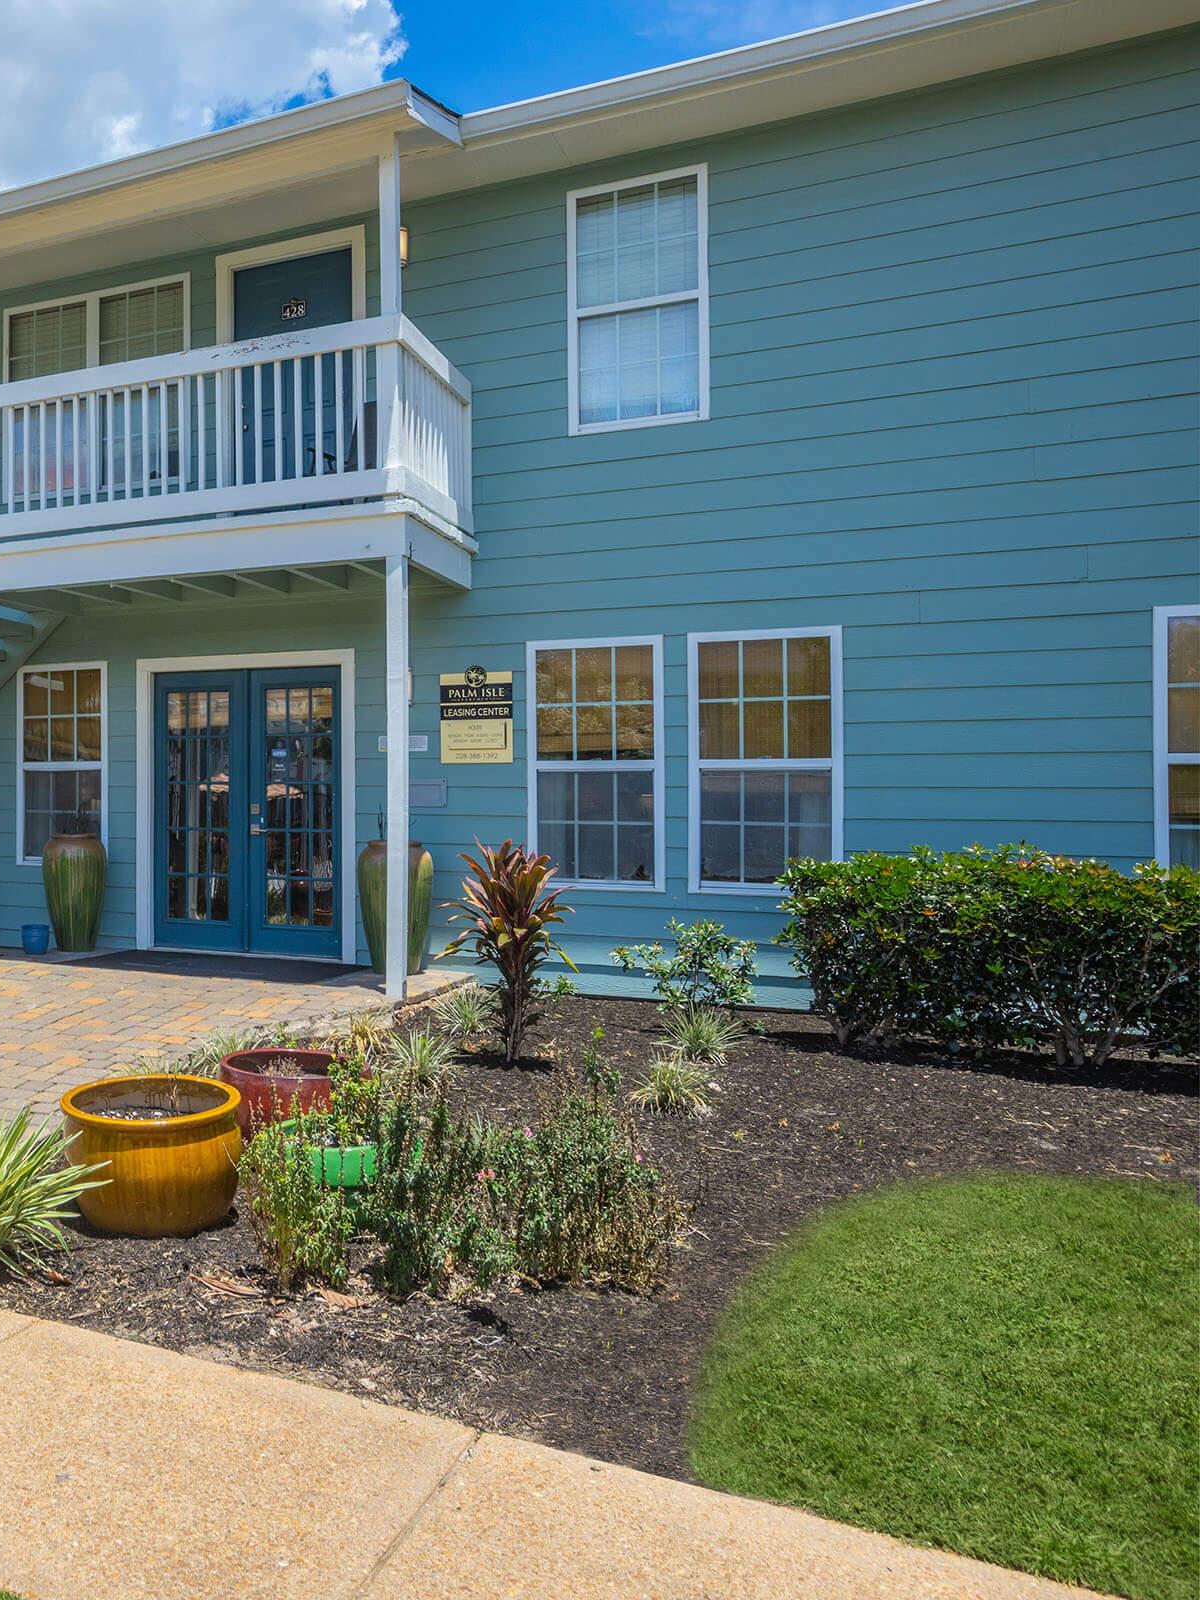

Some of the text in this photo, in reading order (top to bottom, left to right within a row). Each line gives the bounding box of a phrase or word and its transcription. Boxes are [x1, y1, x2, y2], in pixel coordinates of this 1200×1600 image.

[283, 304, 304, 318] 428
[448, 687, 505, 698] PALM ISLE
[443, 707, 510, 717] LEASING CENTER
